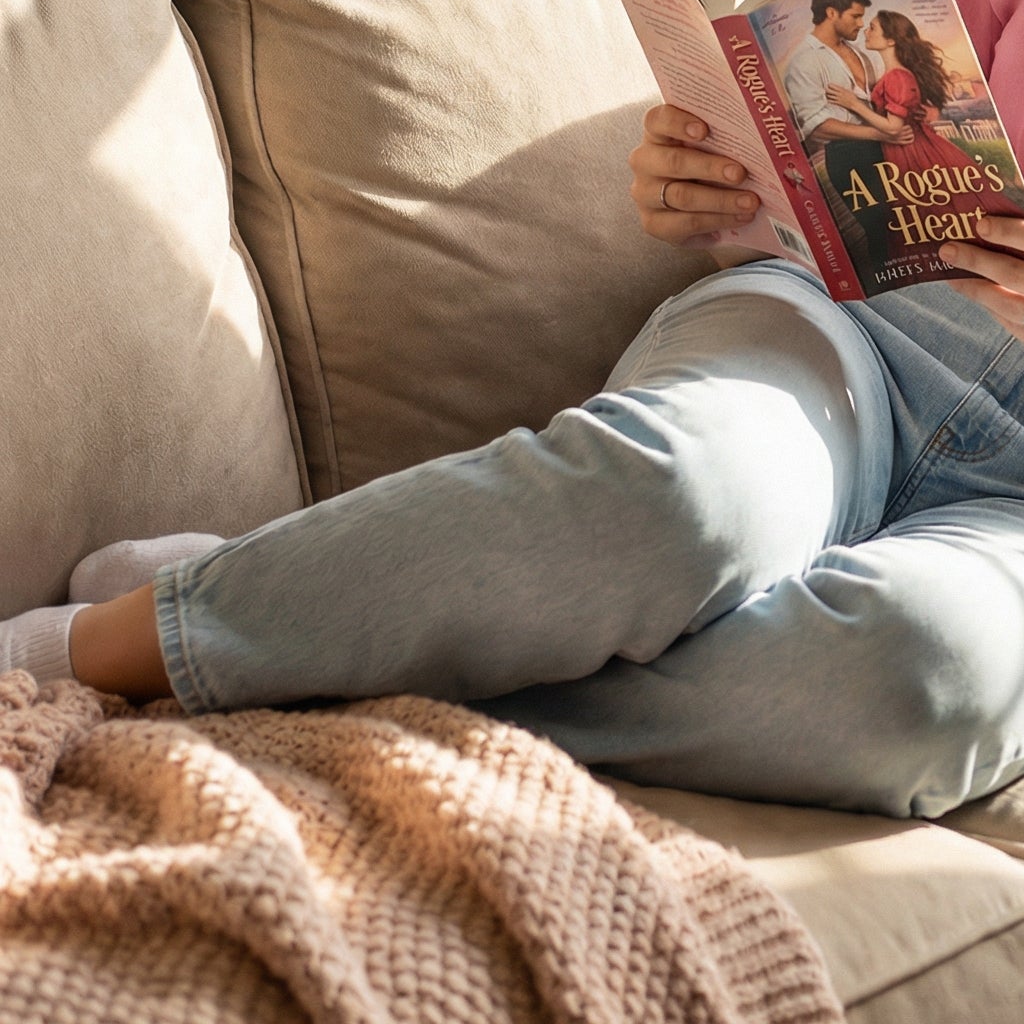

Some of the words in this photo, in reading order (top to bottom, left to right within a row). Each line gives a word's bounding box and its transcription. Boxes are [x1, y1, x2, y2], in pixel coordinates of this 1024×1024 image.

[728, 34, 752, 52] A
[736, 54, 775, 114] Rogue's
[763, 114, 796, 157] Heart
[842, 168, 879, 212] A
[873, 154, 1004, 207] Rogue's
